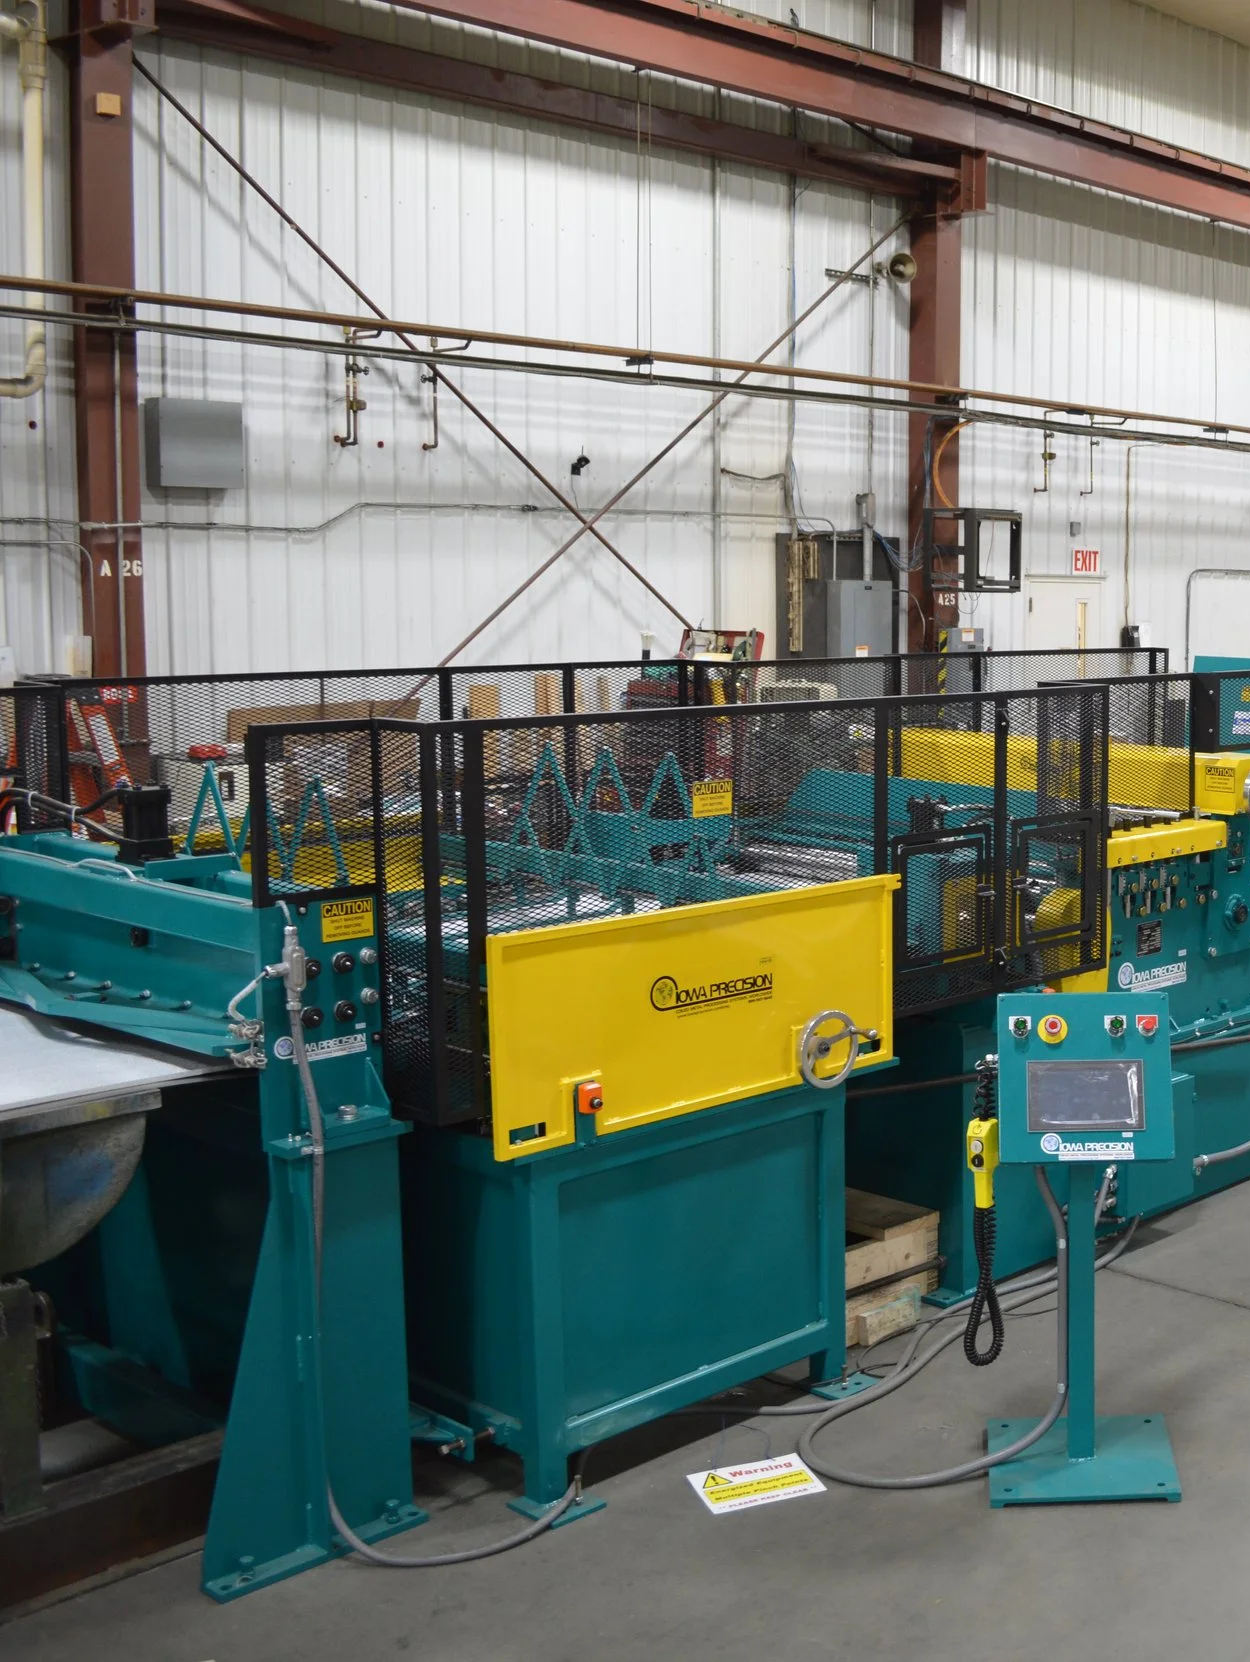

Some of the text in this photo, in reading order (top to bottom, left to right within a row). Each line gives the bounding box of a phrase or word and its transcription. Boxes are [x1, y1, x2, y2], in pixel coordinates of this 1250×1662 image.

[122, 559, 143, 577] 26
[1074, 550, 1099, 572] EXIT
[938, 593, 956, 605] A25
[1206, 767, 1234, 776] CAUTION
[694, 781, 731, 795] CAUTION
[323, 900, 371, 917] CAUTION
[1151, 961, 1187, 978] PRECISION
[675, 973, 773, 1004] IOWA PRECISION
[318, 1033, 366, 1050] PRECISION
[1059, 1142, 1134, 1152] IOWA PRECISION
[729, 1461, 793, 1478] Warning
[710, 1472, 803, 1494] Energized Equipment
[715, 1478, 808, 1501] Multiple Pinch Points
